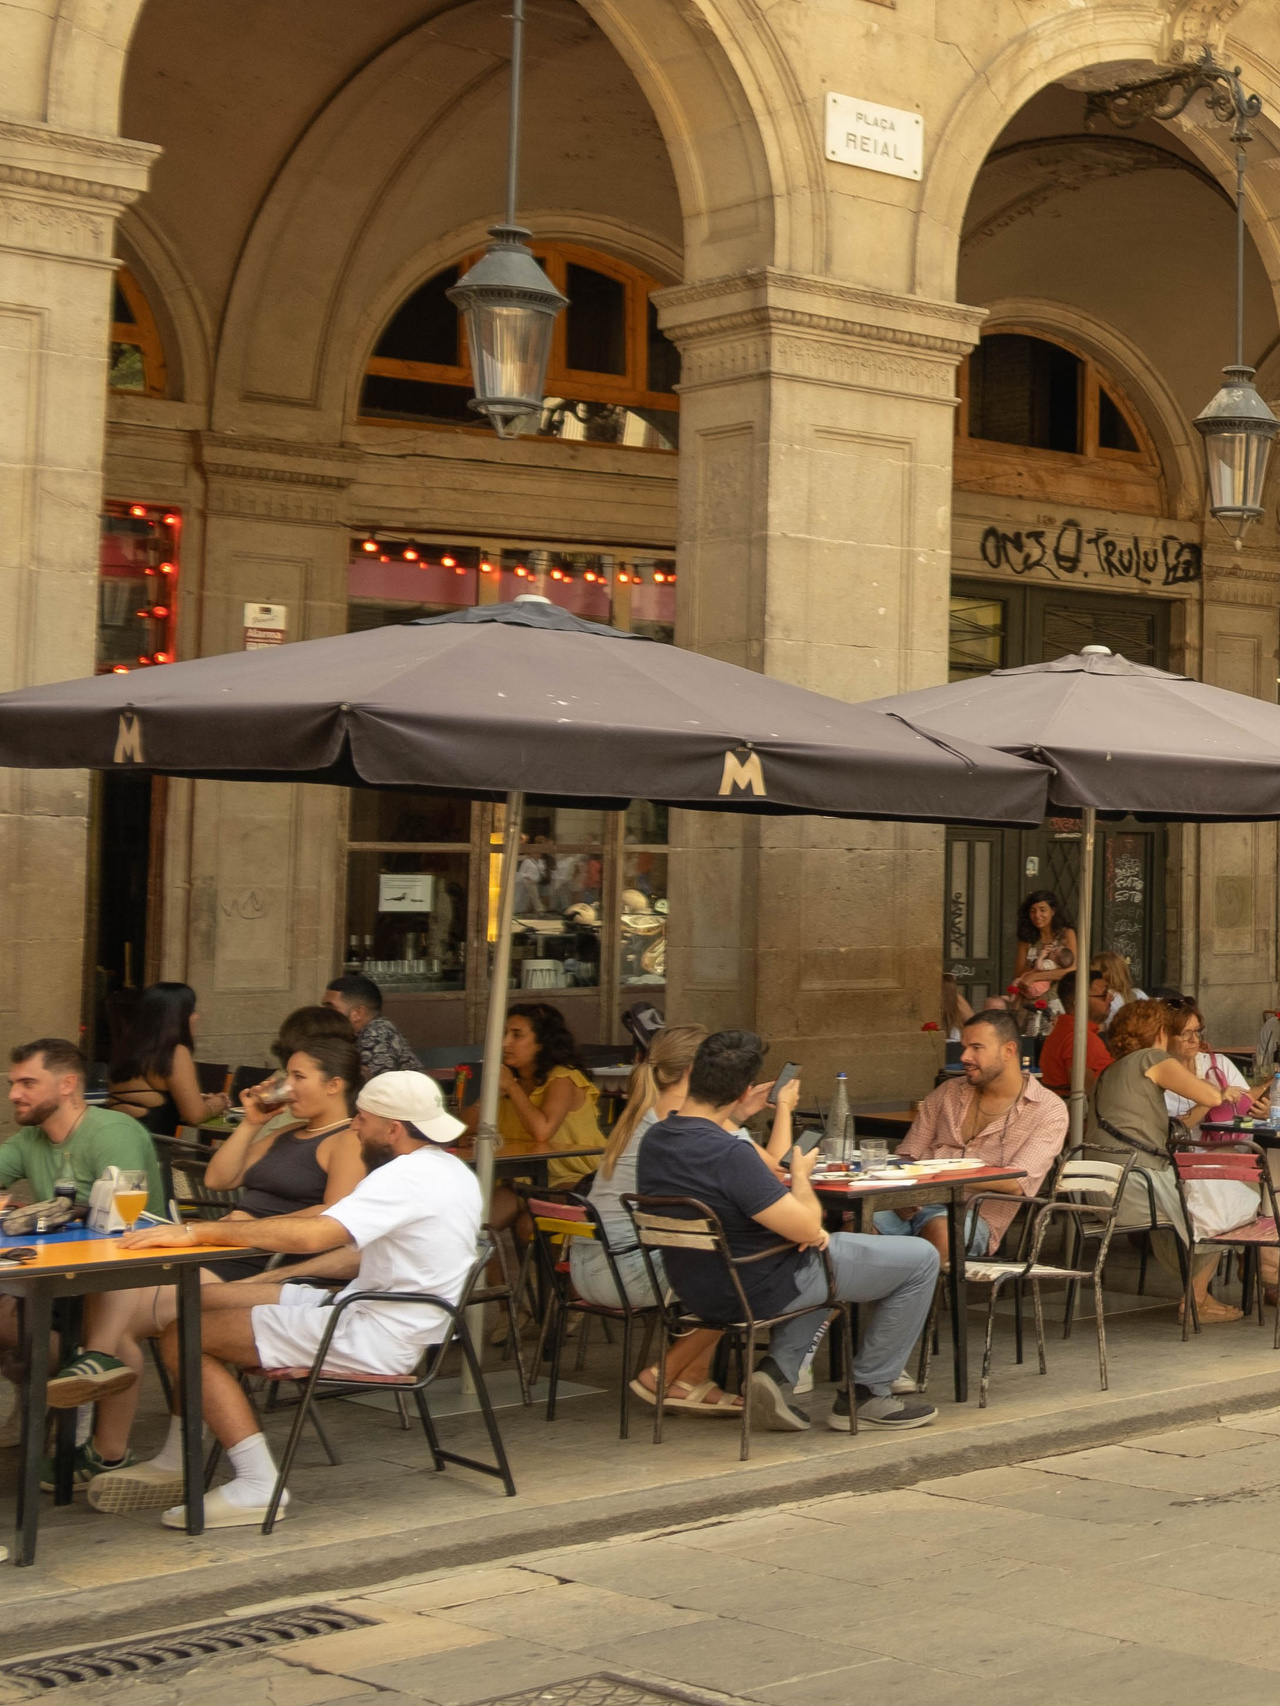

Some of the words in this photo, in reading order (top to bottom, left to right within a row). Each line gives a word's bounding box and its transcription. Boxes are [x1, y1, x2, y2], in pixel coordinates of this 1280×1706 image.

[855, 111, 896, 132] PLAÇA
[846, 132, 904, 161] REIAL
[114, 714, 144, 763] M
[718, 750, 767, 795] M
